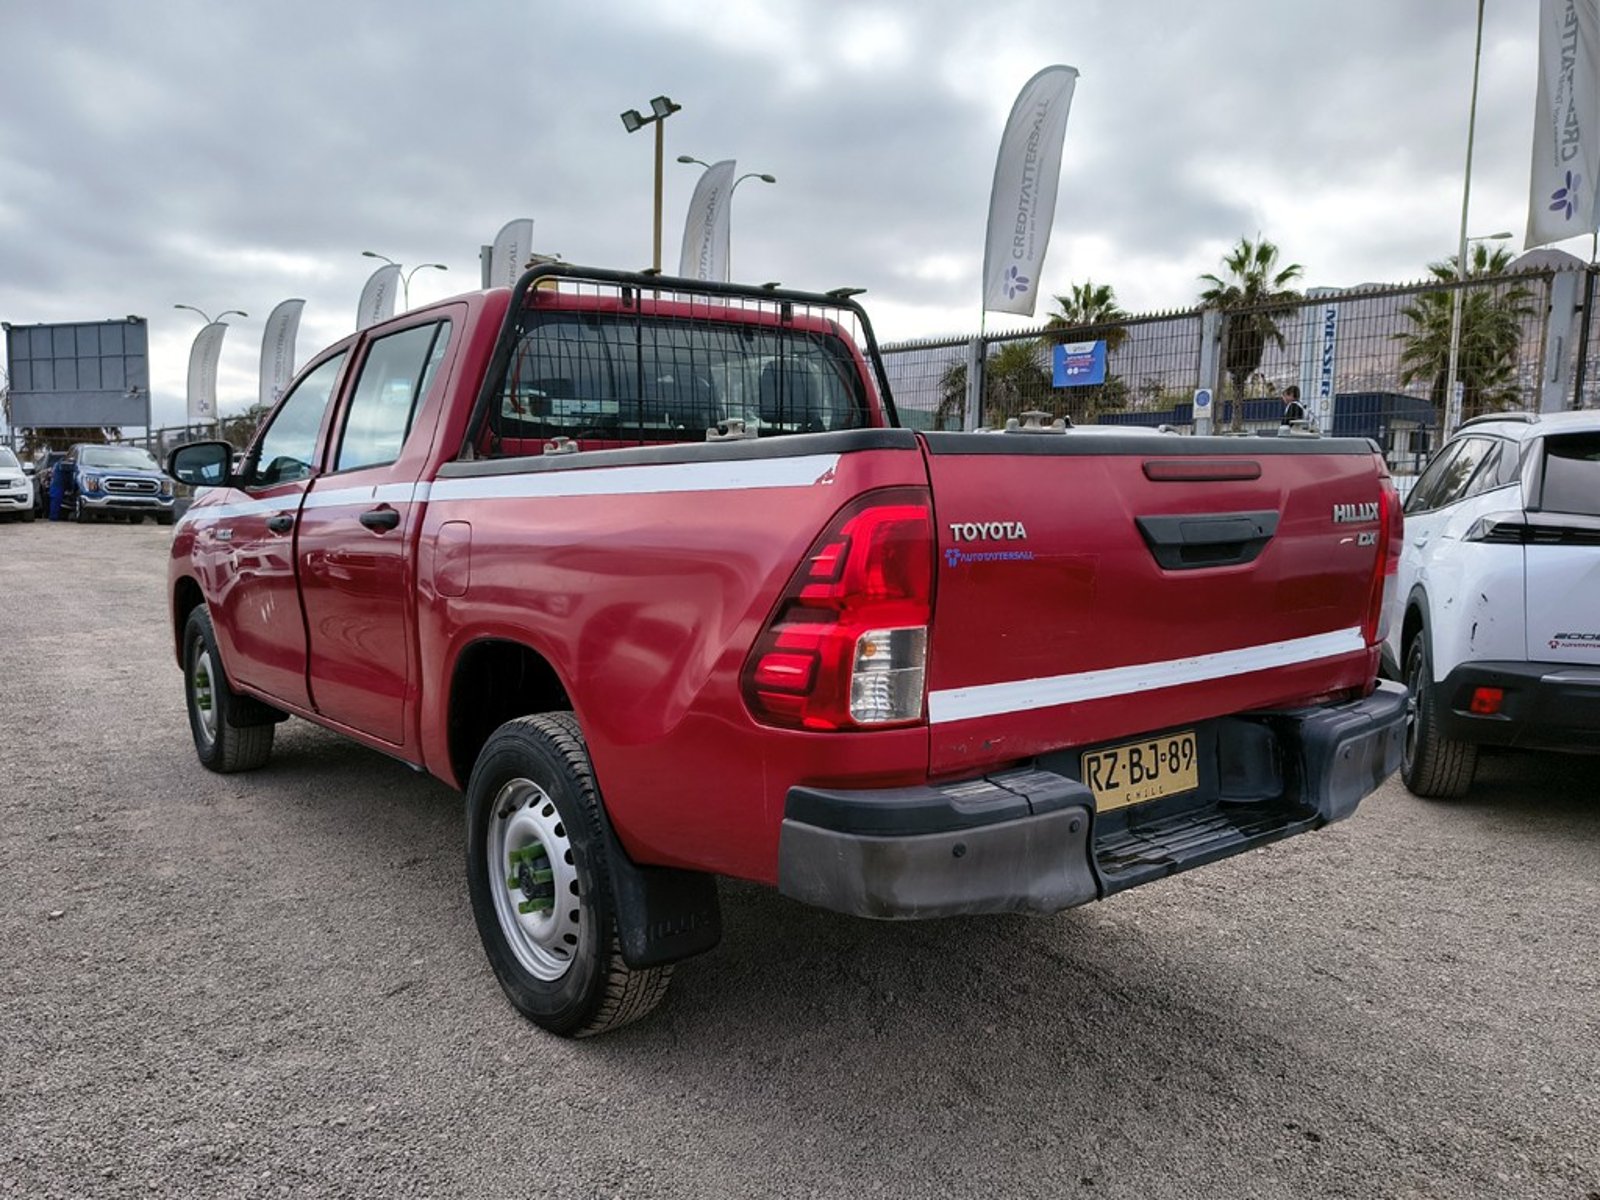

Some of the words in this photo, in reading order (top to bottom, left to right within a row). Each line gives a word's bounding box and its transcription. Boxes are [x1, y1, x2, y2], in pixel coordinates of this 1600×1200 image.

[1012, 100, 1050, 260] CREDITATTERSALL
[1321, 309, 1336, 396] MESSER
[949, 521, 1027, 541] TOYOTA
[1333, 502, 1379, 523] HILUX
